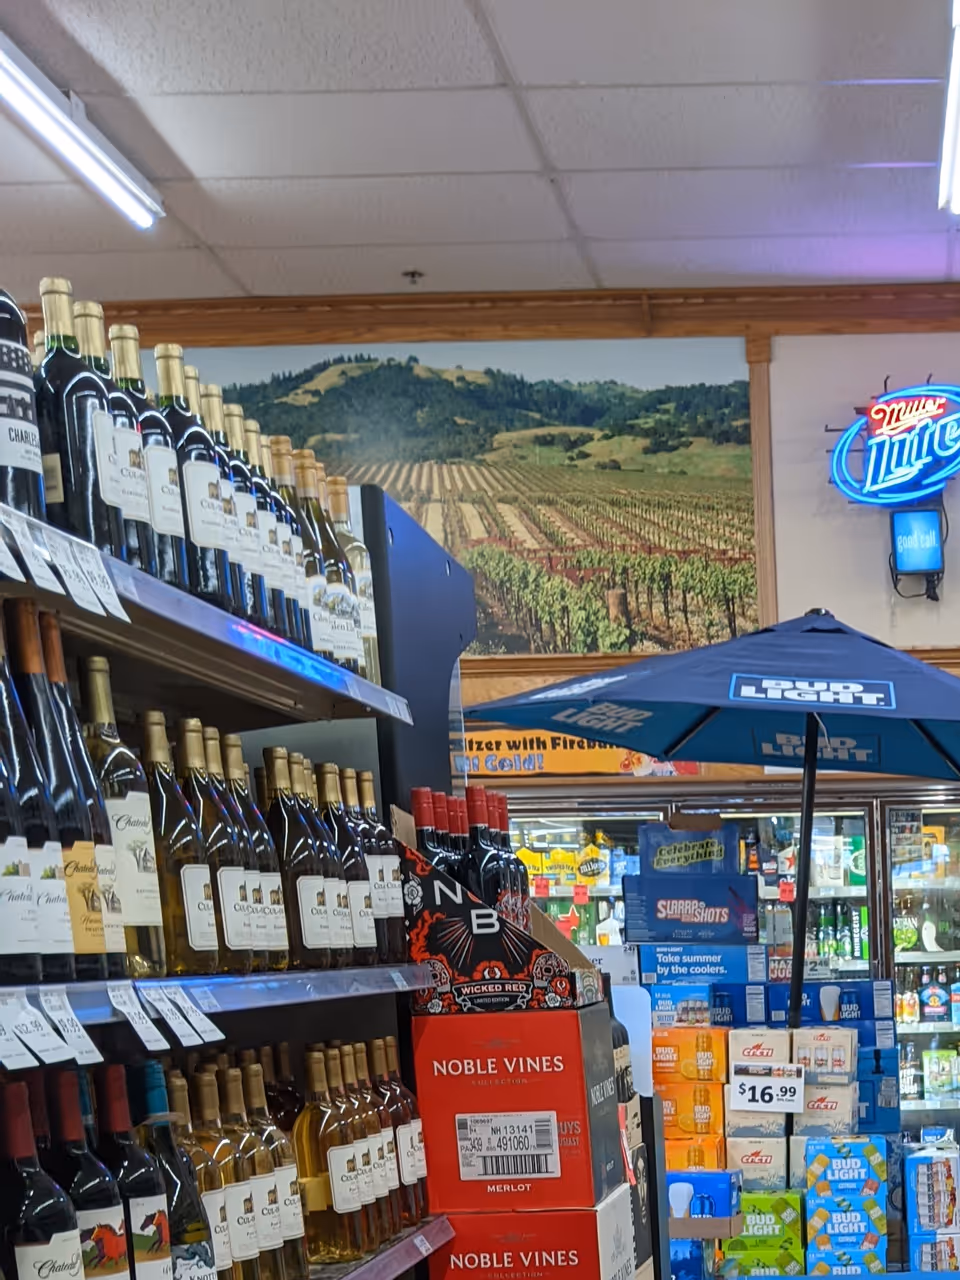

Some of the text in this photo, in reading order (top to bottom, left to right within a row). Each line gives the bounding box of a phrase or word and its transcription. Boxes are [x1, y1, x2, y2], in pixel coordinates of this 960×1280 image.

[870, 397, 946, 435] Miller
[762, 679, 864, 693] BUD
[587, 701, 653, 720] BUD
[551, 708, 643, 733] LIGHT
[507, 737, 547, 750] with
[433, 880, 463, 905] N
[695, 907, 729, 923] SHOTS
[470, 908, 500, 935] B
[656, 954, 722, 963] Take summer
[657, 965, 727, 975] by the coolers.
[461, 984, 527, 995] WICKED RED
[841, 1004, 859, 1012] BUD
[653, 1053, 678, 1061] LIGHT
[655, 1047, 673, 1055] BUD
[433, 1056, 564, 1077] NOBLE VINES
[738, 1082, 797, 1104] $16.99
[832, 1158, 861, 1169] BUD
[826, 1168, 867, 1180] LIGHT
[487, 1183, 532, 1193] MERLOT
[746, 1213, 776, 1225] BUD
[832, 1213, 861, 1224] BUD
[743, 1223, 782, 1236] LIGHT
[826, 1222, 867, 1234] LIGHT
[450, 1249, 579, 1270] NOBLE VINES
